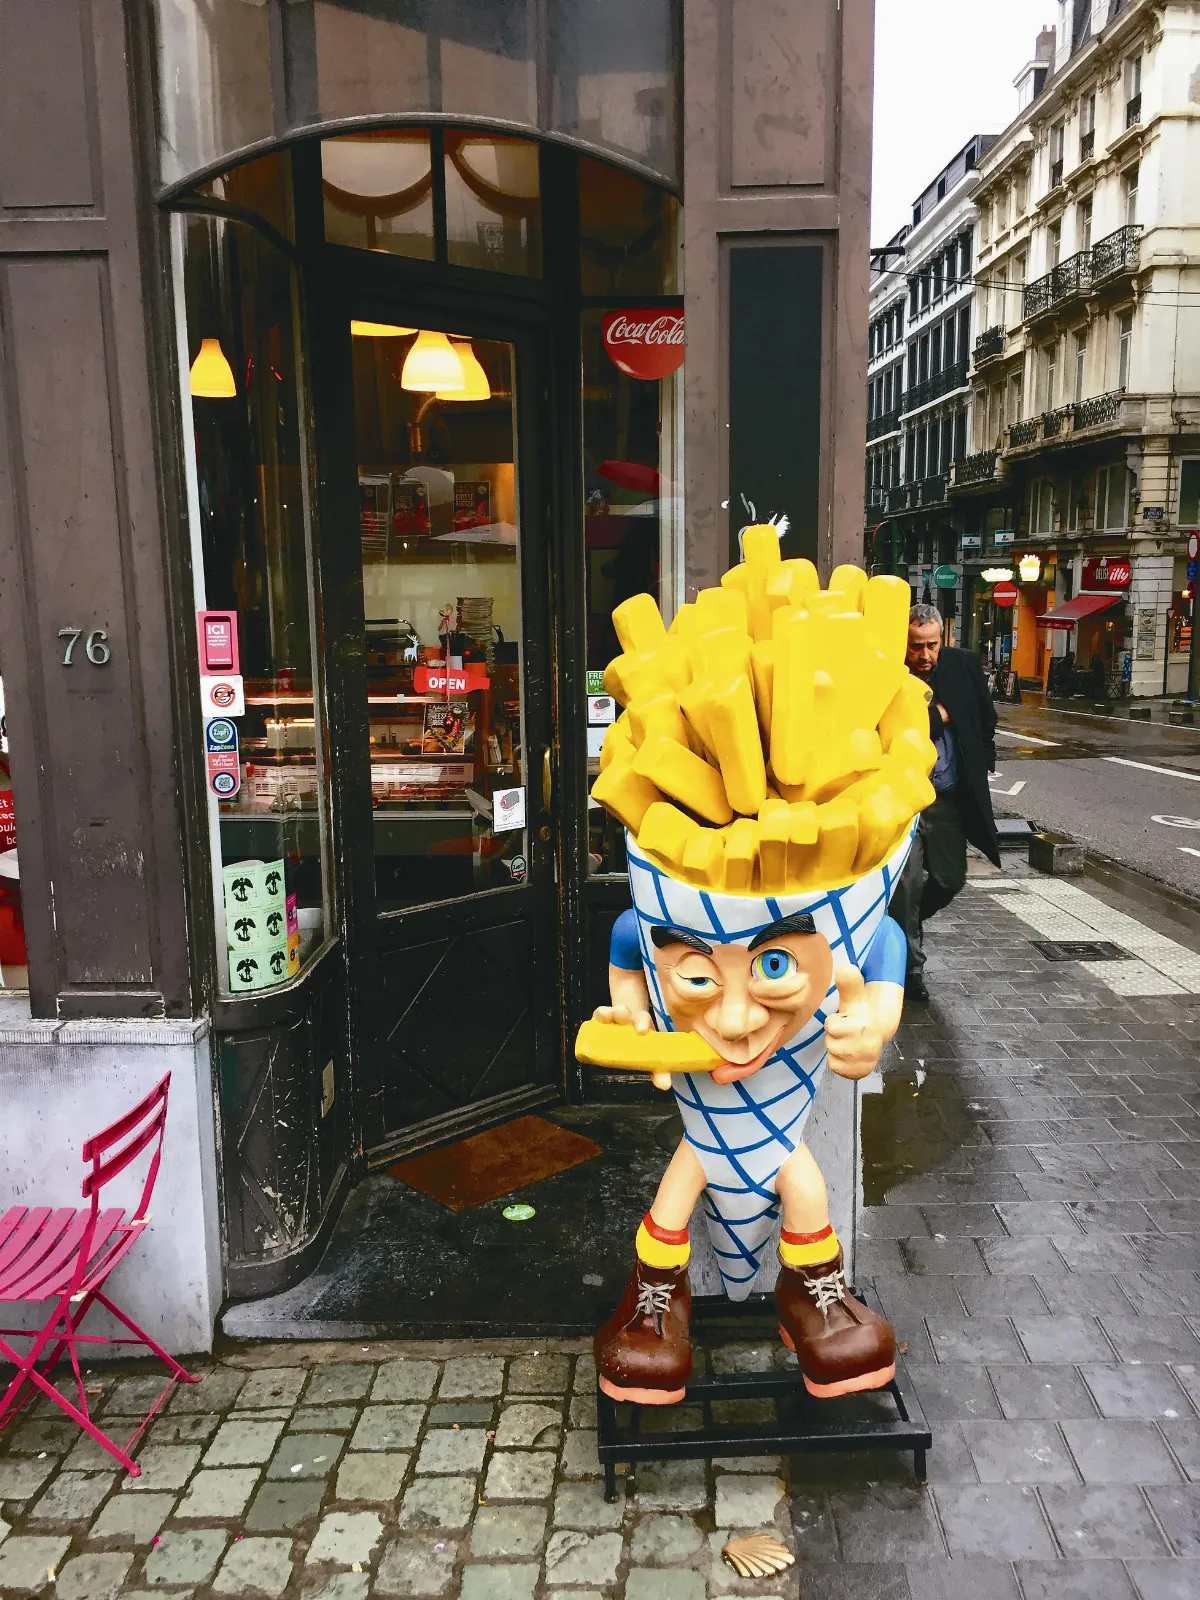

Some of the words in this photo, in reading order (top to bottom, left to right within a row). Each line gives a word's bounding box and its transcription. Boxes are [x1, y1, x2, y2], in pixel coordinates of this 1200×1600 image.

[606, 316, 684, 345] Coca-Cola
[1109, 567, 1129, 584] illy
[207, 624, 224, 635] ICI
[59, 629, 110, 664] 76
[428, 676, 466, 690] OPEN
[589, 672, 603, 680] FRE
